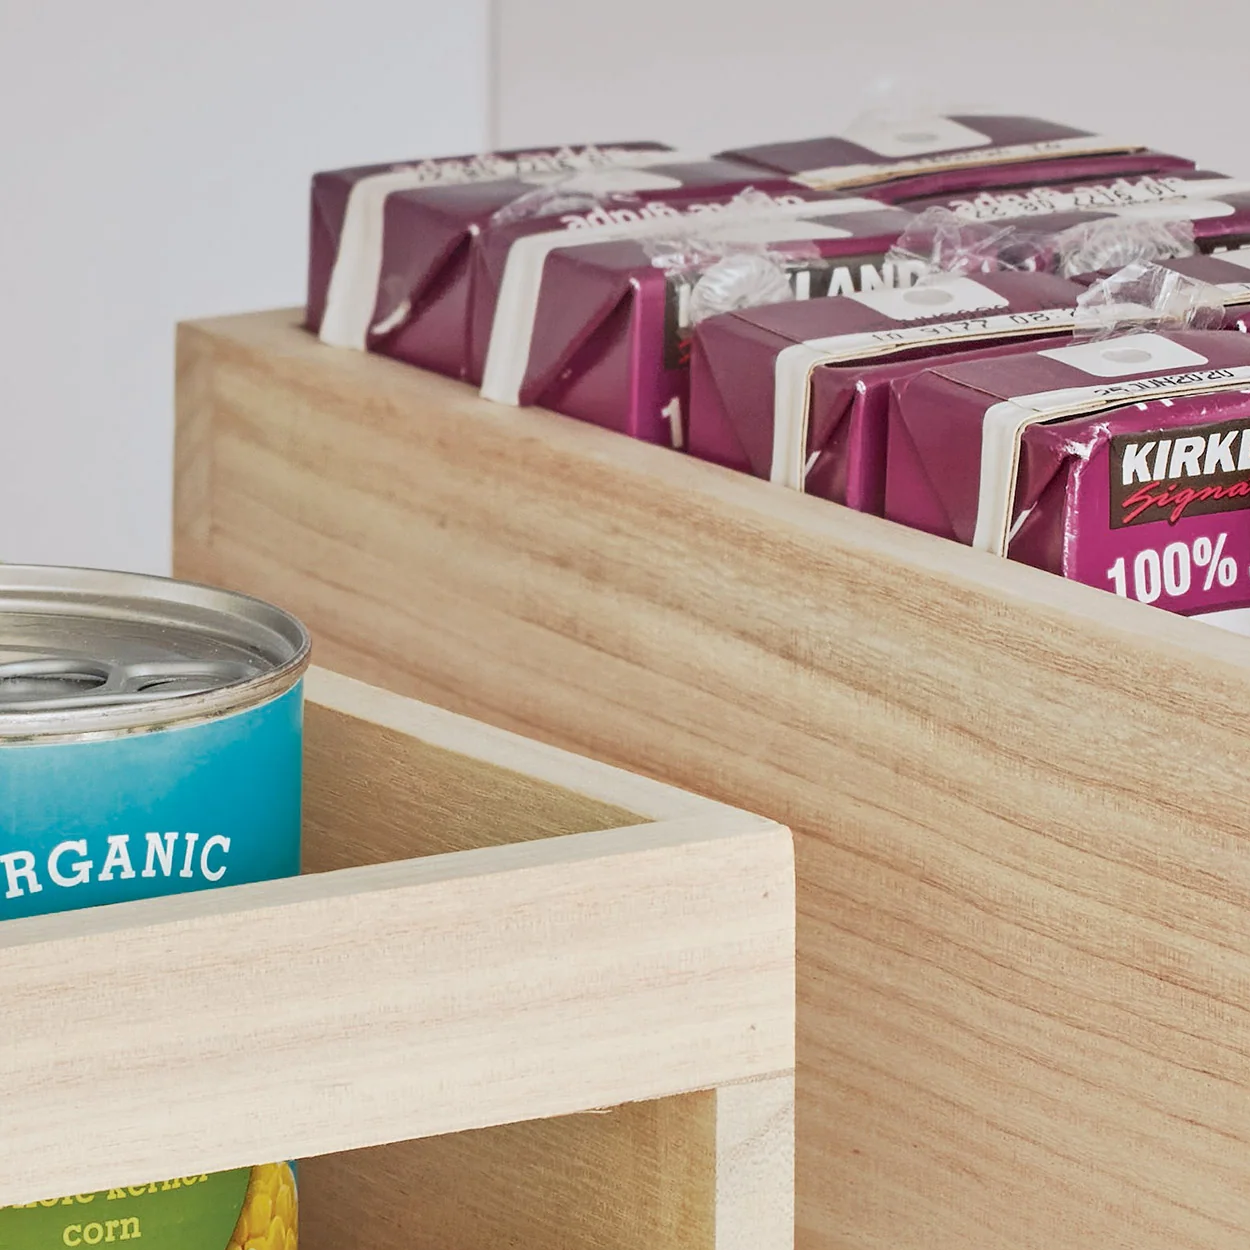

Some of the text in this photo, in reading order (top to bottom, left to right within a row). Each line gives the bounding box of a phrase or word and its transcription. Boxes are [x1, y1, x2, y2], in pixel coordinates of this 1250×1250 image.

[1107, 532, 1238, 604] 100%
[0, 831, 231, 899] RGANIC
[62, 1215, 142, 1247] corn
